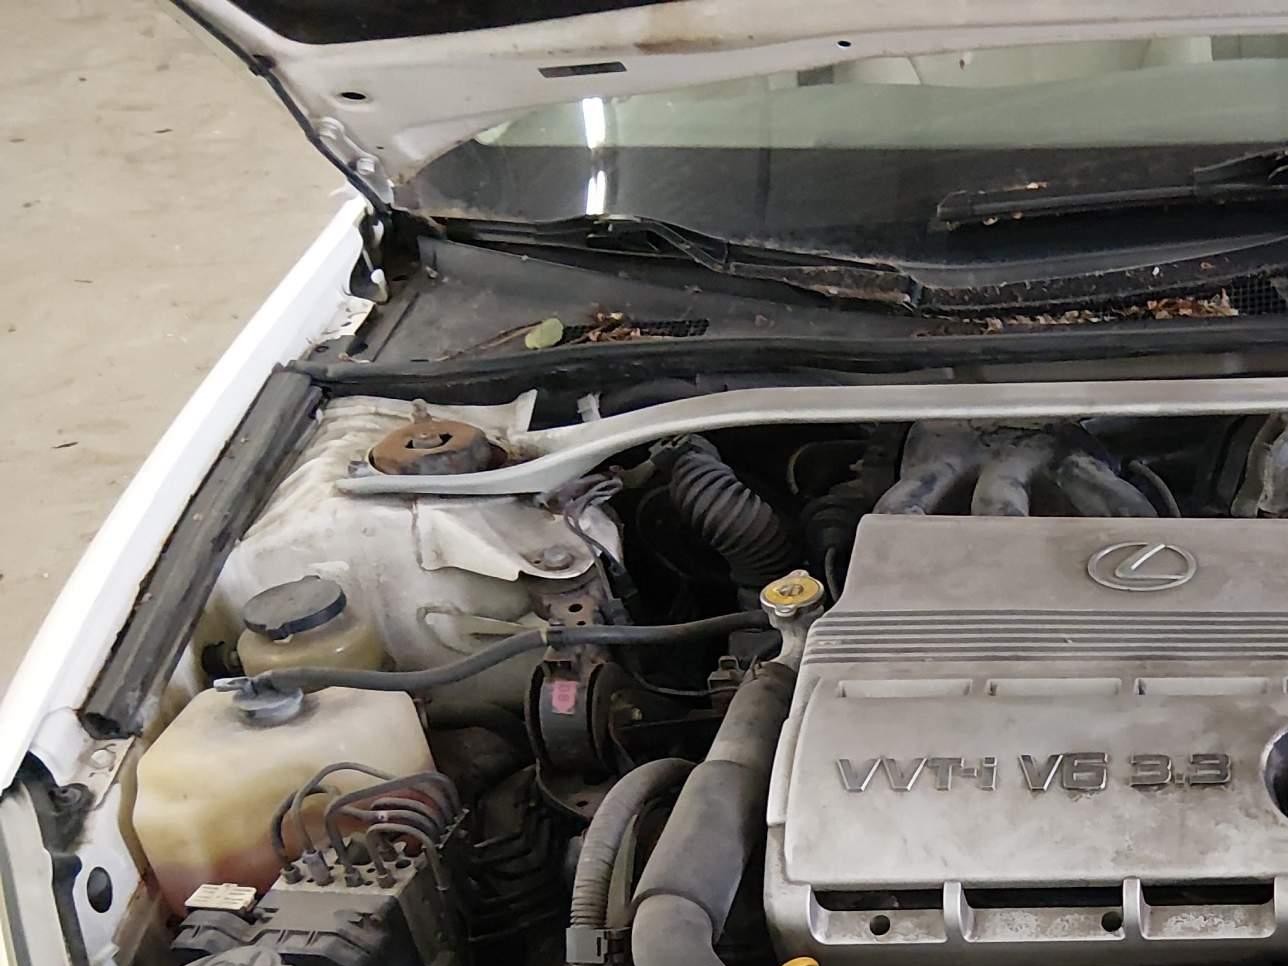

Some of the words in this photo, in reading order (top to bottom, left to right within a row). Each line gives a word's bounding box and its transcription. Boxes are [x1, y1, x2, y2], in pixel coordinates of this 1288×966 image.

[836, 754, 998, 792] VVT-i
[1017, 752, 1109, 792] V6
[1128, 752, 1234, 788] 3.3
